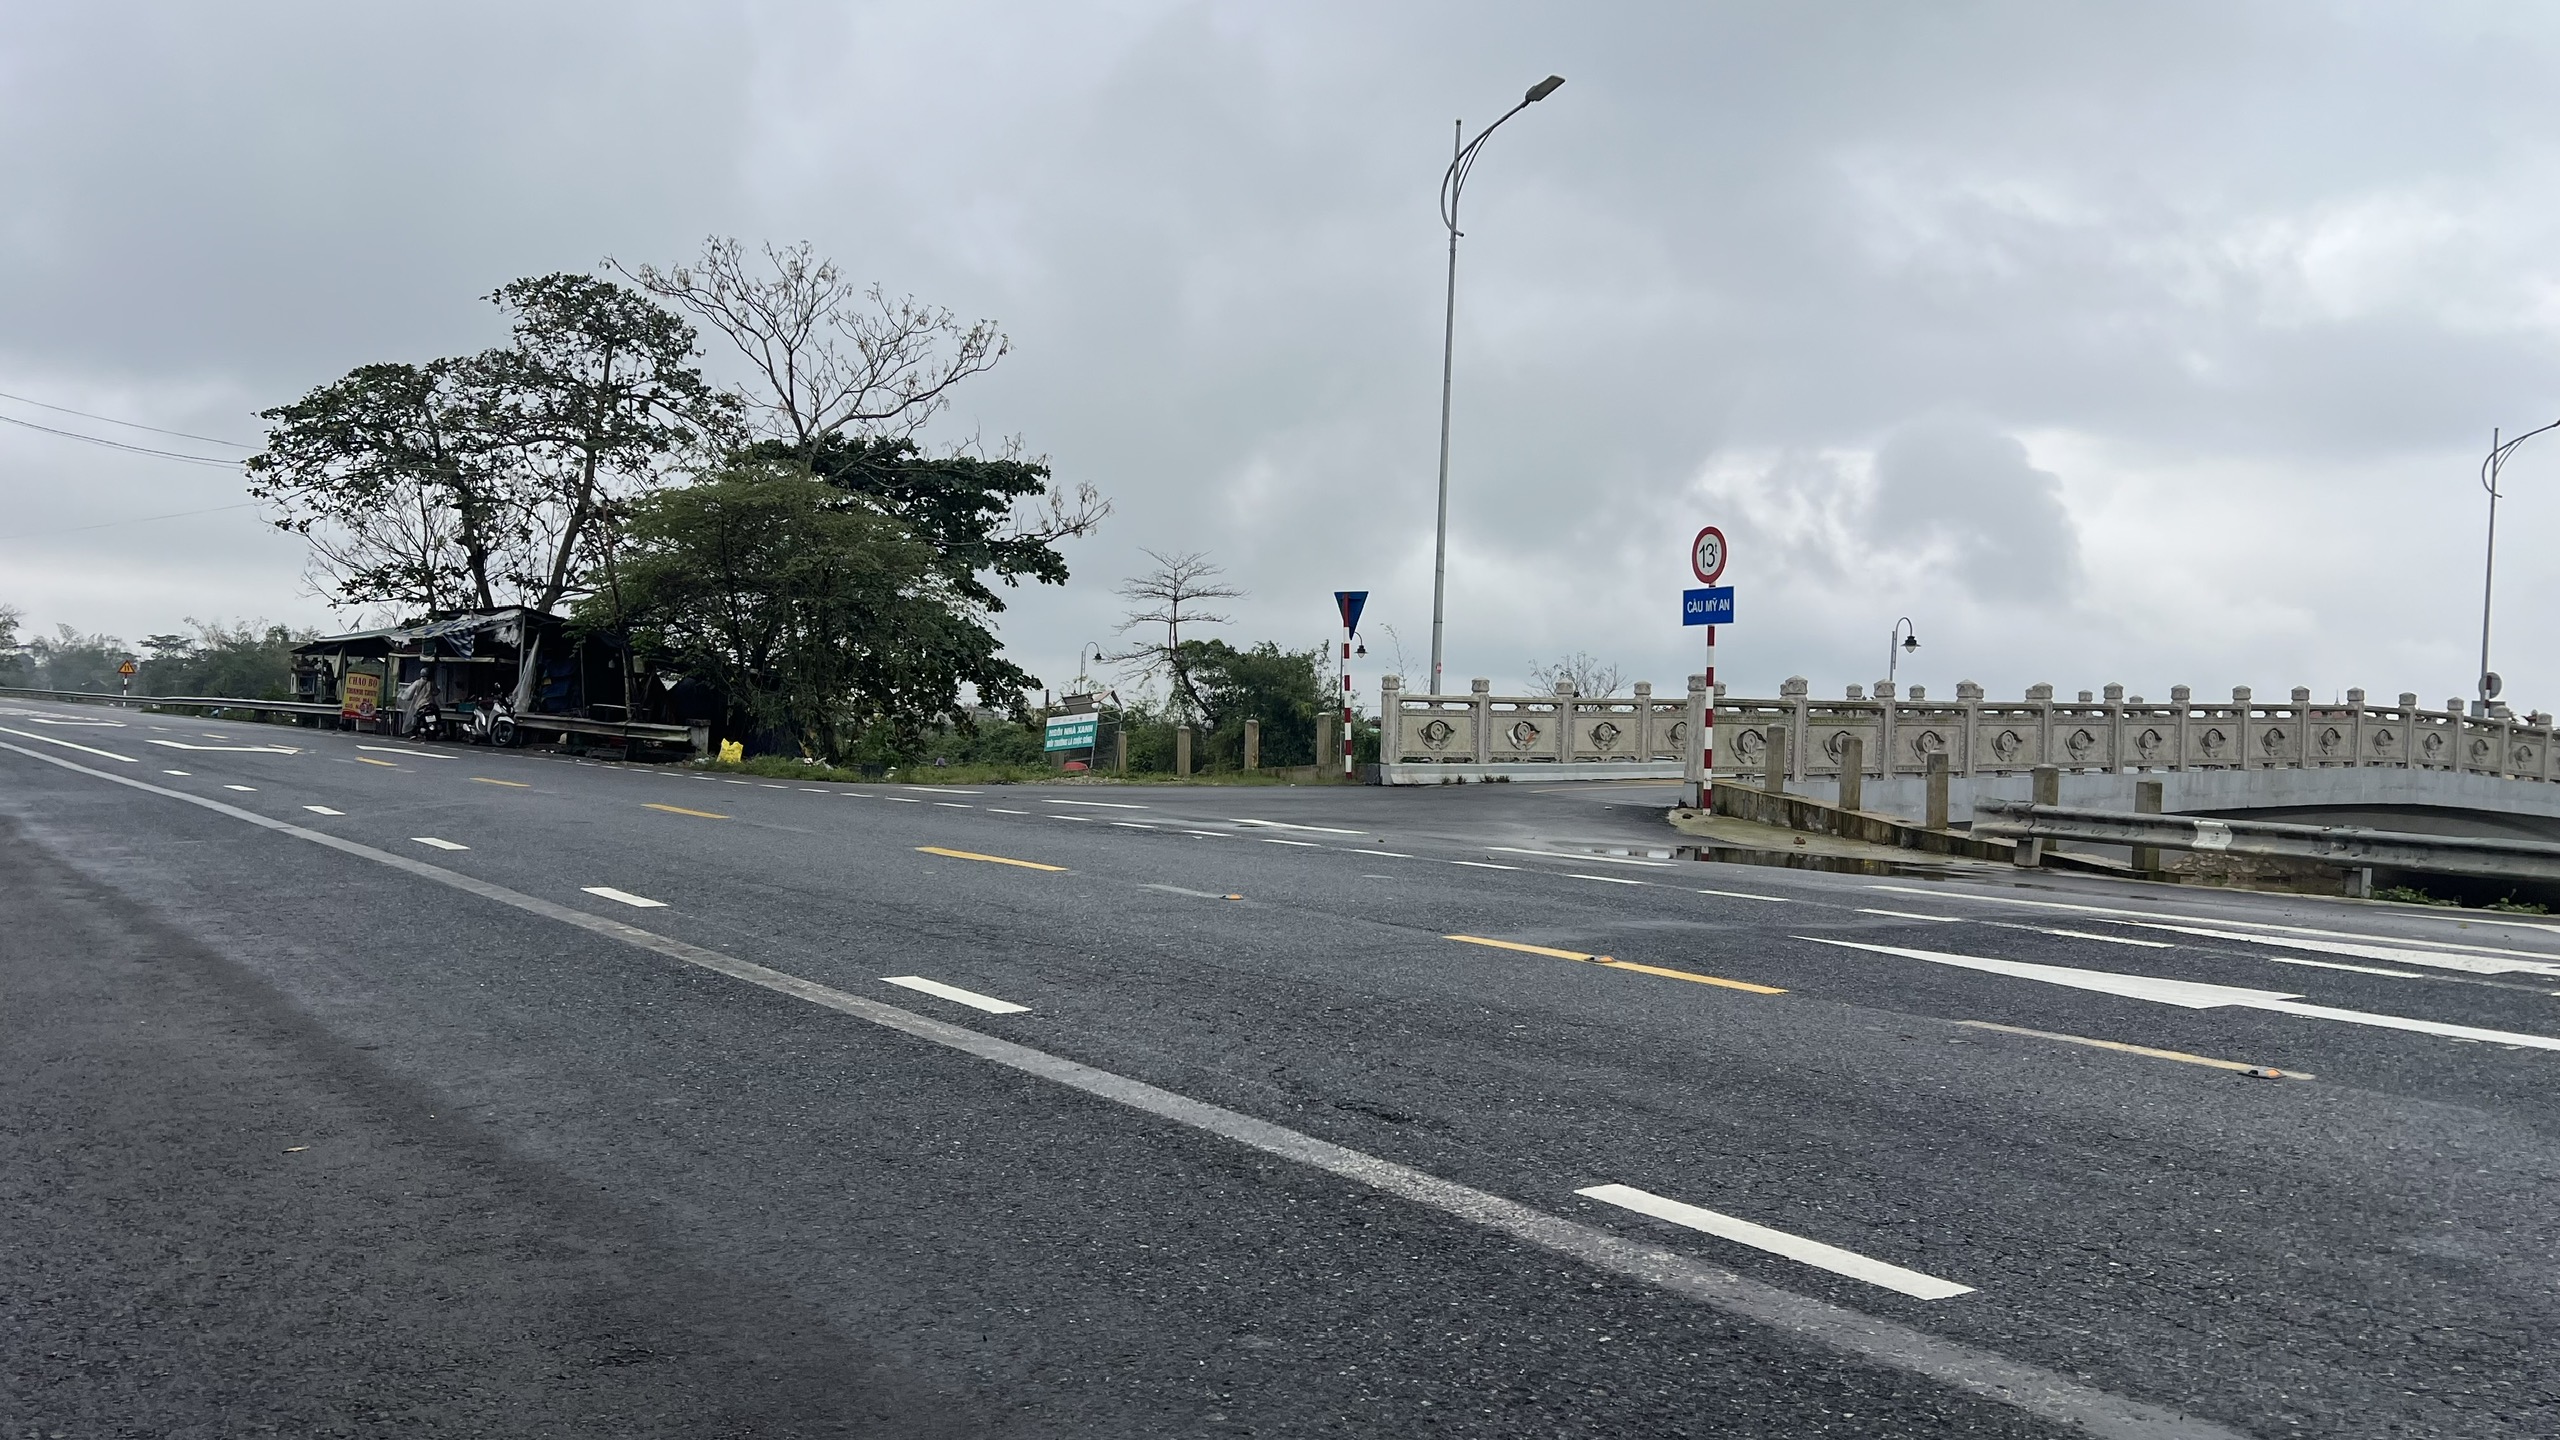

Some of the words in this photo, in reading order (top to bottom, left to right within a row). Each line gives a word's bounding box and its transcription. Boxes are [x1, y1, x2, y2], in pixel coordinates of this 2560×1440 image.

[1705, 597, 1718, 612] MỸ
[1718, 598, 1730, 611] AN
[1077, 724, 1094, 734] XANH
